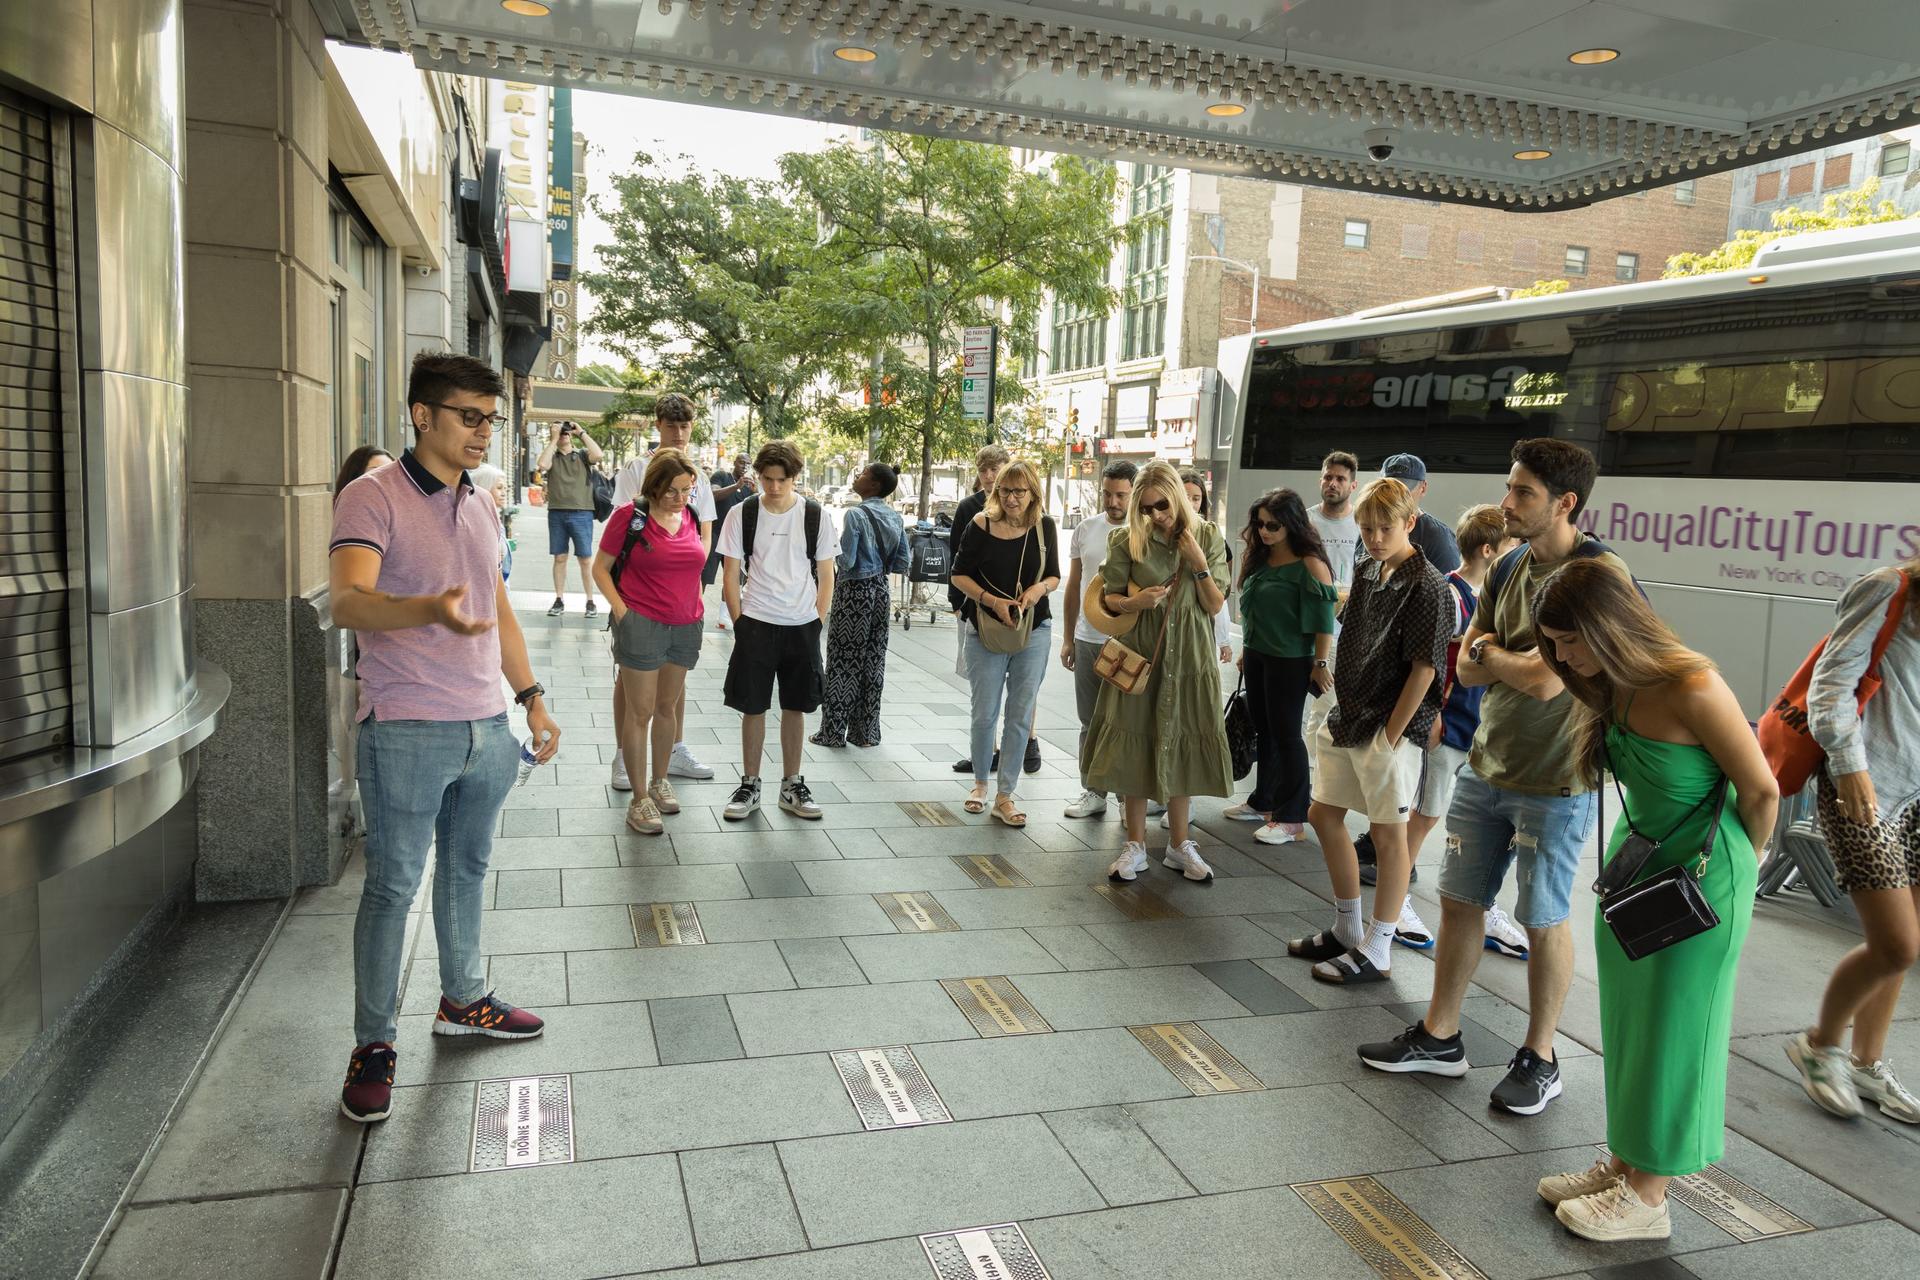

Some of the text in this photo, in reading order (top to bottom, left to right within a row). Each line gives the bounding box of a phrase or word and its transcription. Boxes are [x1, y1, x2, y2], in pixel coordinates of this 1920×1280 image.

[1719, 563, 1850, 592] New York City
[993, 1007, 1015, 1026] STEVIE
[1169, 1034, 1222, 1080] LITTLE RICHARD
[870, 1060, 908, 1113] BILLIE HOLIDAY
[517, 1086, 530, 1157] DIONNE WARWICK
[1340, 1192, 1440, 1277] ARETHA FRANKLIN
[977, 1255, 1002, 1280] HAN
